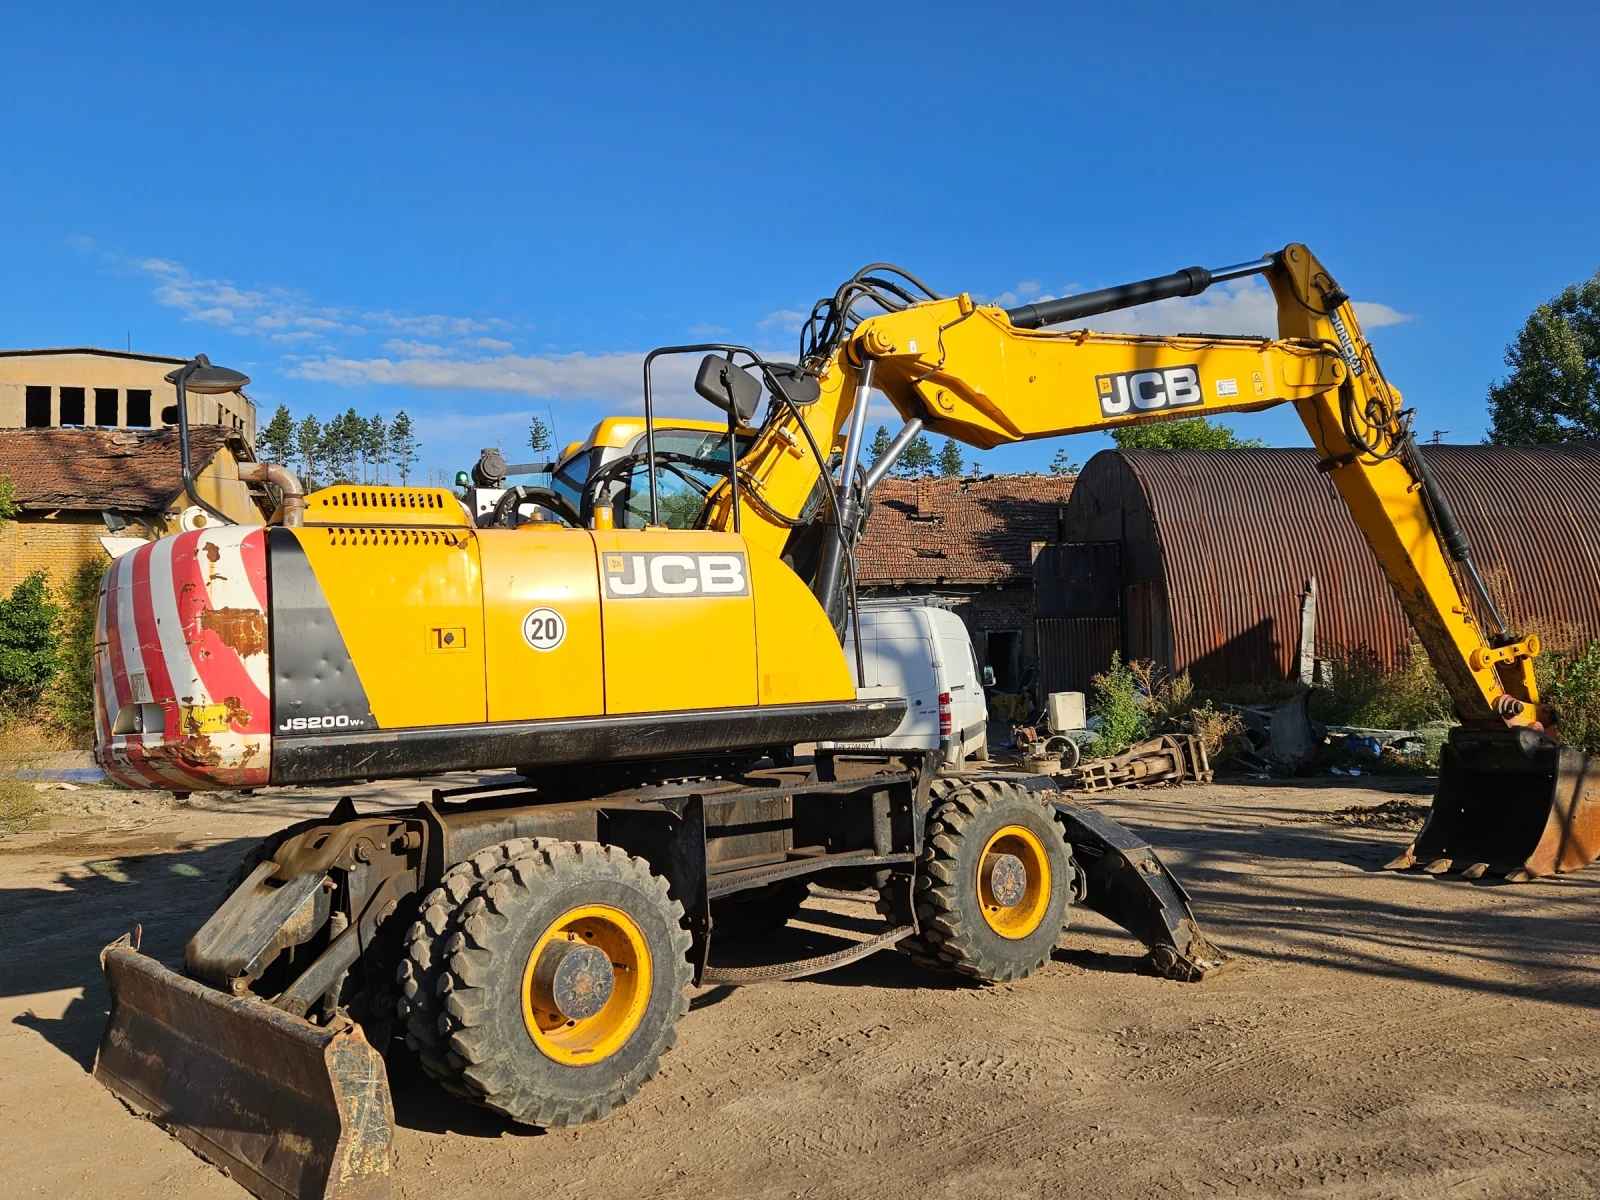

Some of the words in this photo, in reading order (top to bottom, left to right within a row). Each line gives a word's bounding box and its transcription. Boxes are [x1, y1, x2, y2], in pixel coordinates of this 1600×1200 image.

[1101, 368, 1200, 413] JCB
[609, 555, 745, 595] JCB
[531, 617, 558, 640] 20
